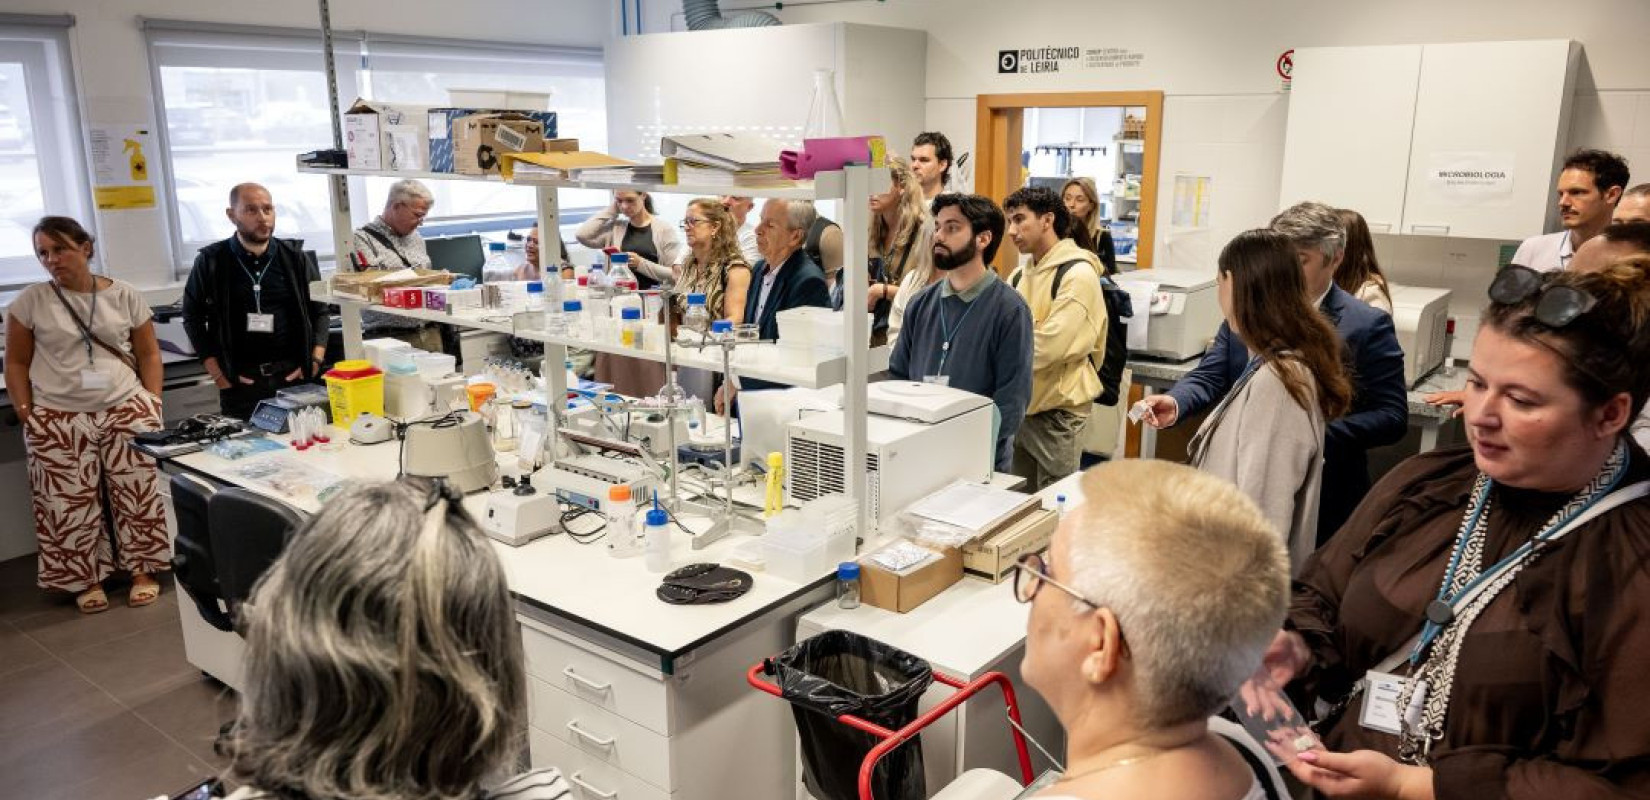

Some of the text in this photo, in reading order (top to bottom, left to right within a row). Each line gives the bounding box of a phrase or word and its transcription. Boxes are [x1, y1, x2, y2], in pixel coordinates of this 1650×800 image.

[1020, 45, 1080, 61] POLITÉCNICO
[1030, 60, 1060, 73] LEIRIA
[1438, 171, 1506, 179] MICROBIOLOGIA
